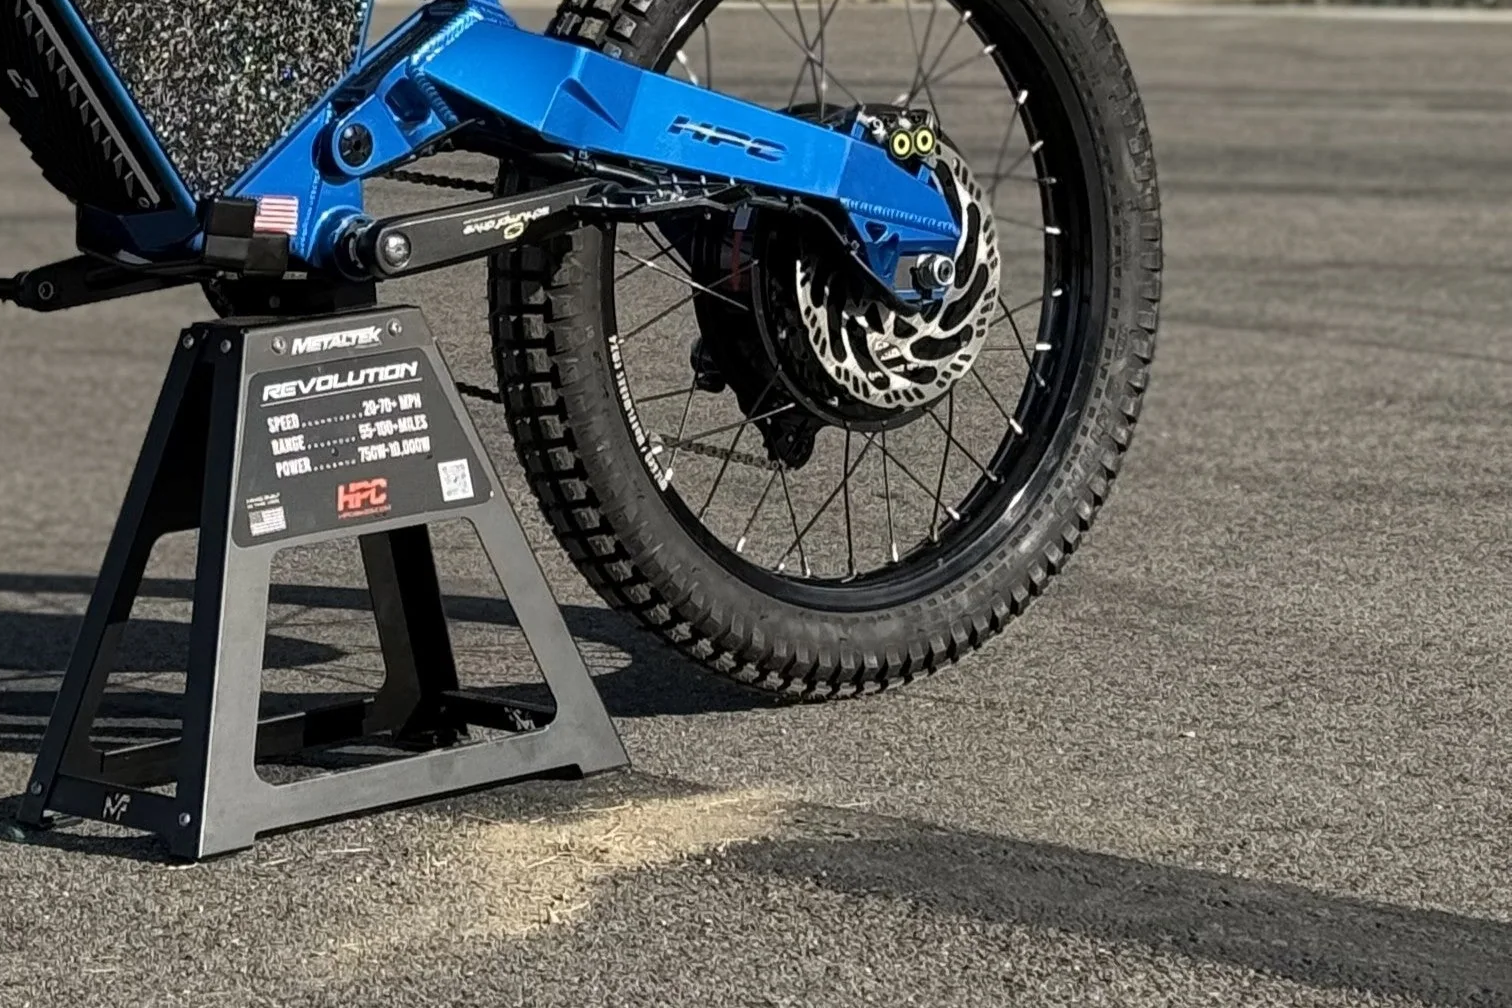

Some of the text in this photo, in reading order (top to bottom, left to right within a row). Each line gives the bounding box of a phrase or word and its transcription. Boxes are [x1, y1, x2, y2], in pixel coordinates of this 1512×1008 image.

[667, 114, 788, 163] HPC
[262, 361, 419, 401] REVOLUTION
[267, 413, 300, 433] SPEED
[398, 393, 422, 410] MPH
[271, 434, 306, 455] RANGE
[275, 457, 312, 478] POWER
[338, 478, 387, 512] HPC
